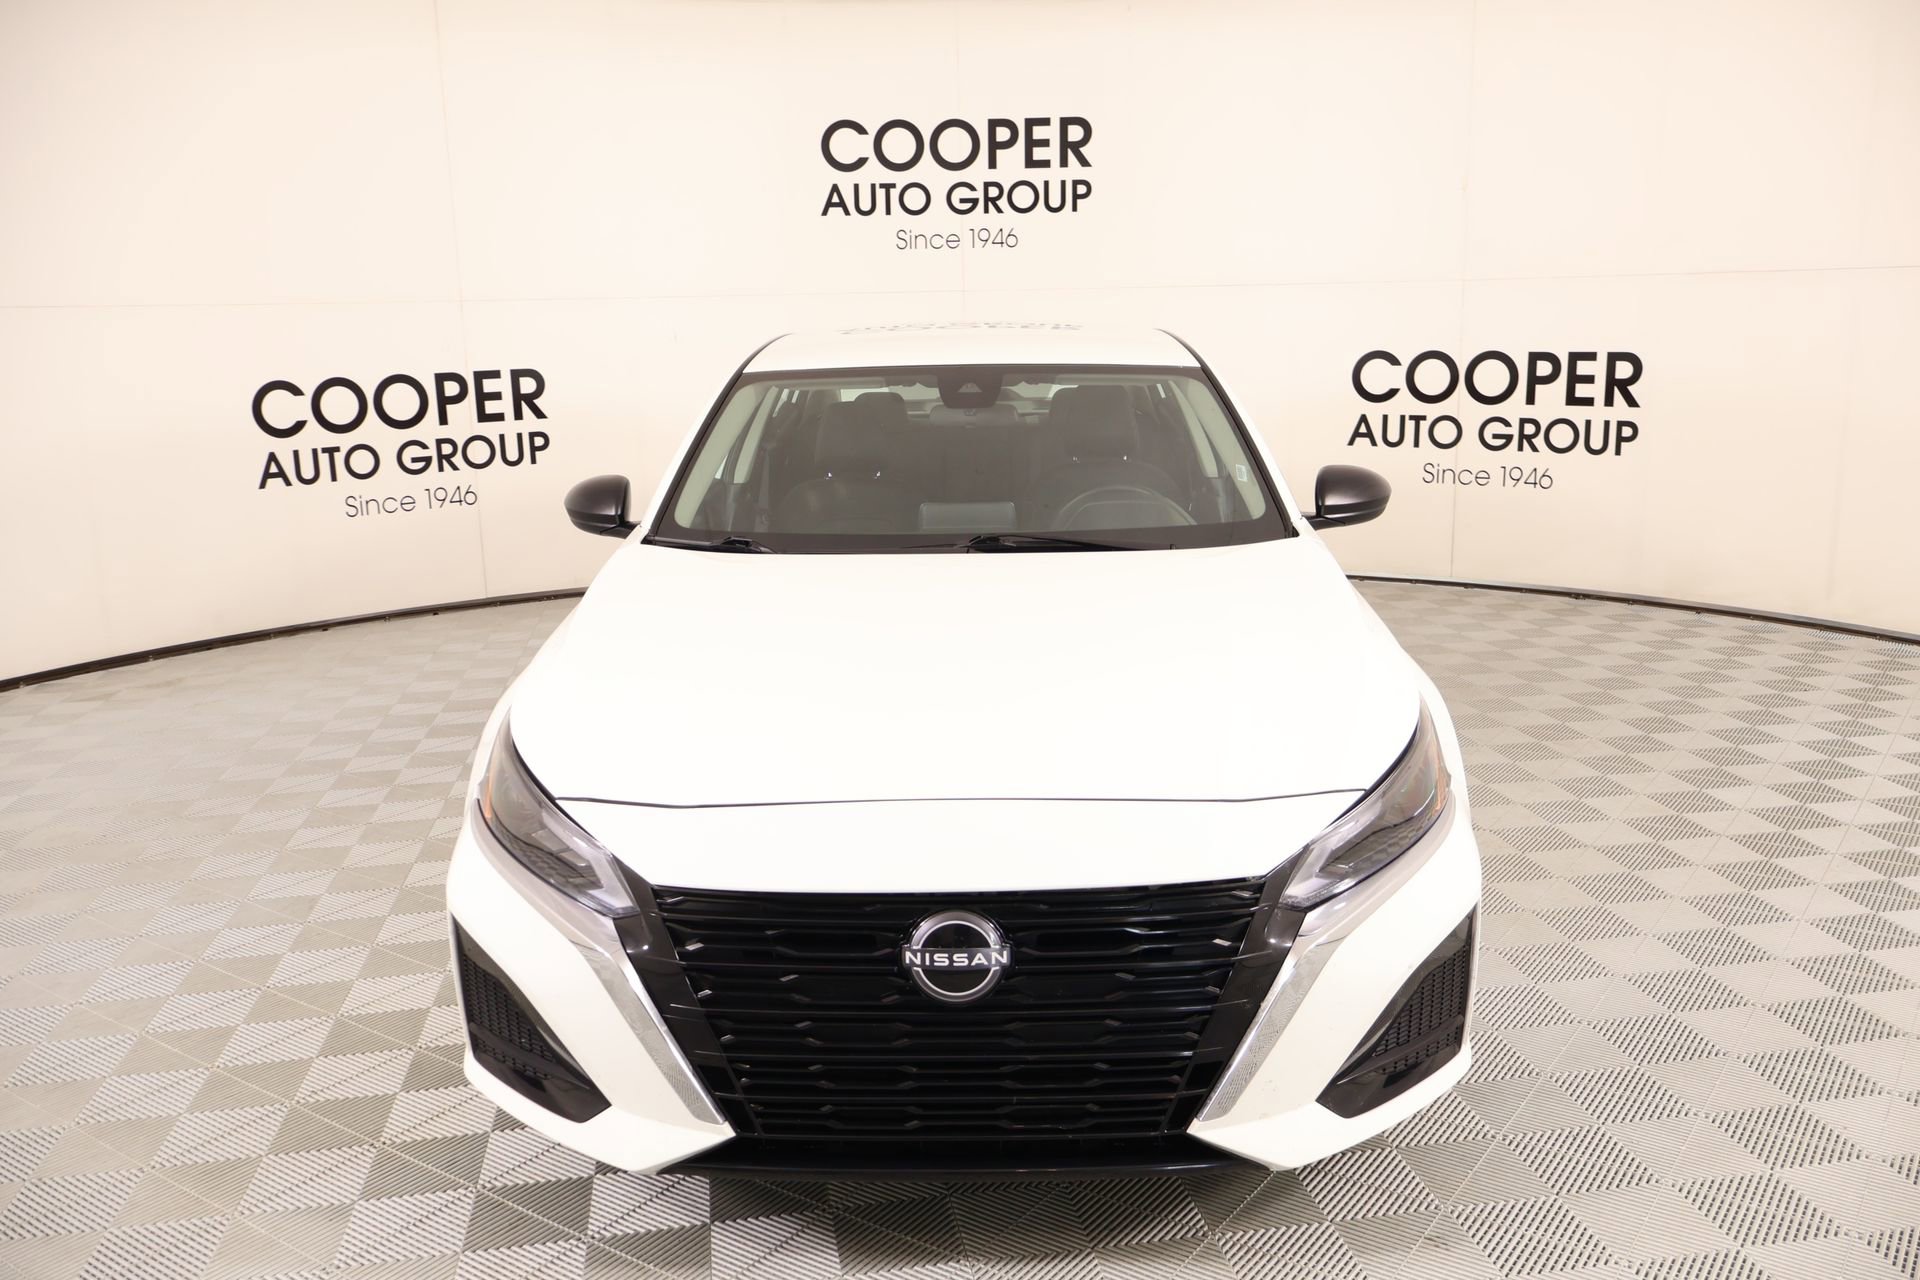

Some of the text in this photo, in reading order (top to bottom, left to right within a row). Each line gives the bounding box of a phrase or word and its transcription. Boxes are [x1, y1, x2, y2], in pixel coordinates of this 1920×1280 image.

[820, 116, 1093, 173] COOPER
[820, 178, 1093, 217] AUTO GROUP
[896, 227, 1019, 250] Since 1946
[1351, 349, 1644, 409] COOPER
[251, 368, 549, 439] COOPER
[1346, 413, 1639, 457] AUTO GROUP
[258, 430, 551, 490] AUTO GROUP
[1422, 462, 1554, 490] Since 1946
[345, 484, 478, 518] Since 1946
[905, 951, 1007, 966] NISSAN
